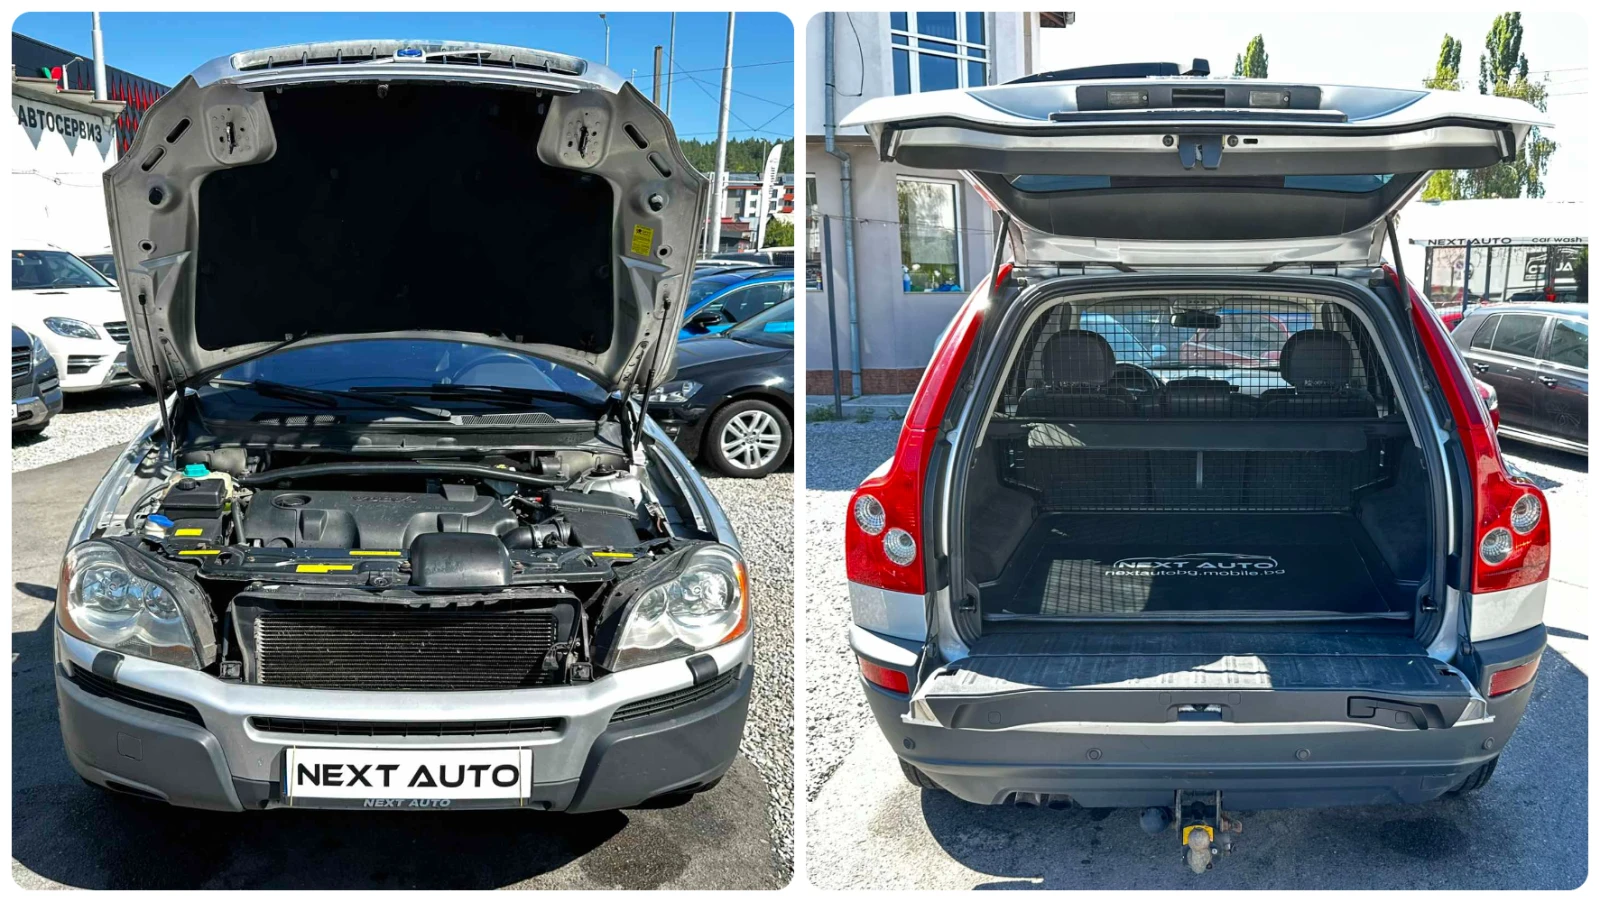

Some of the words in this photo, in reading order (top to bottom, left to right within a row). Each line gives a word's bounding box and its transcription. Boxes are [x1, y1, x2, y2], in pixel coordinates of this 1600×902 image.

[18, 105, 102, 143] АВТОСЕРВИЗ
[1428, 238, 1466, 246] NEXT
[1470, 237, 1512, 245] AUTO
[1118, 561, 1189, 569] NEXT
[297, 763, 400, 787] NEXT
[407, 764, 519, 787] AUTO
[363, 798, 403, 807] NEXT
[409, 799, 451, 807] AUTO
